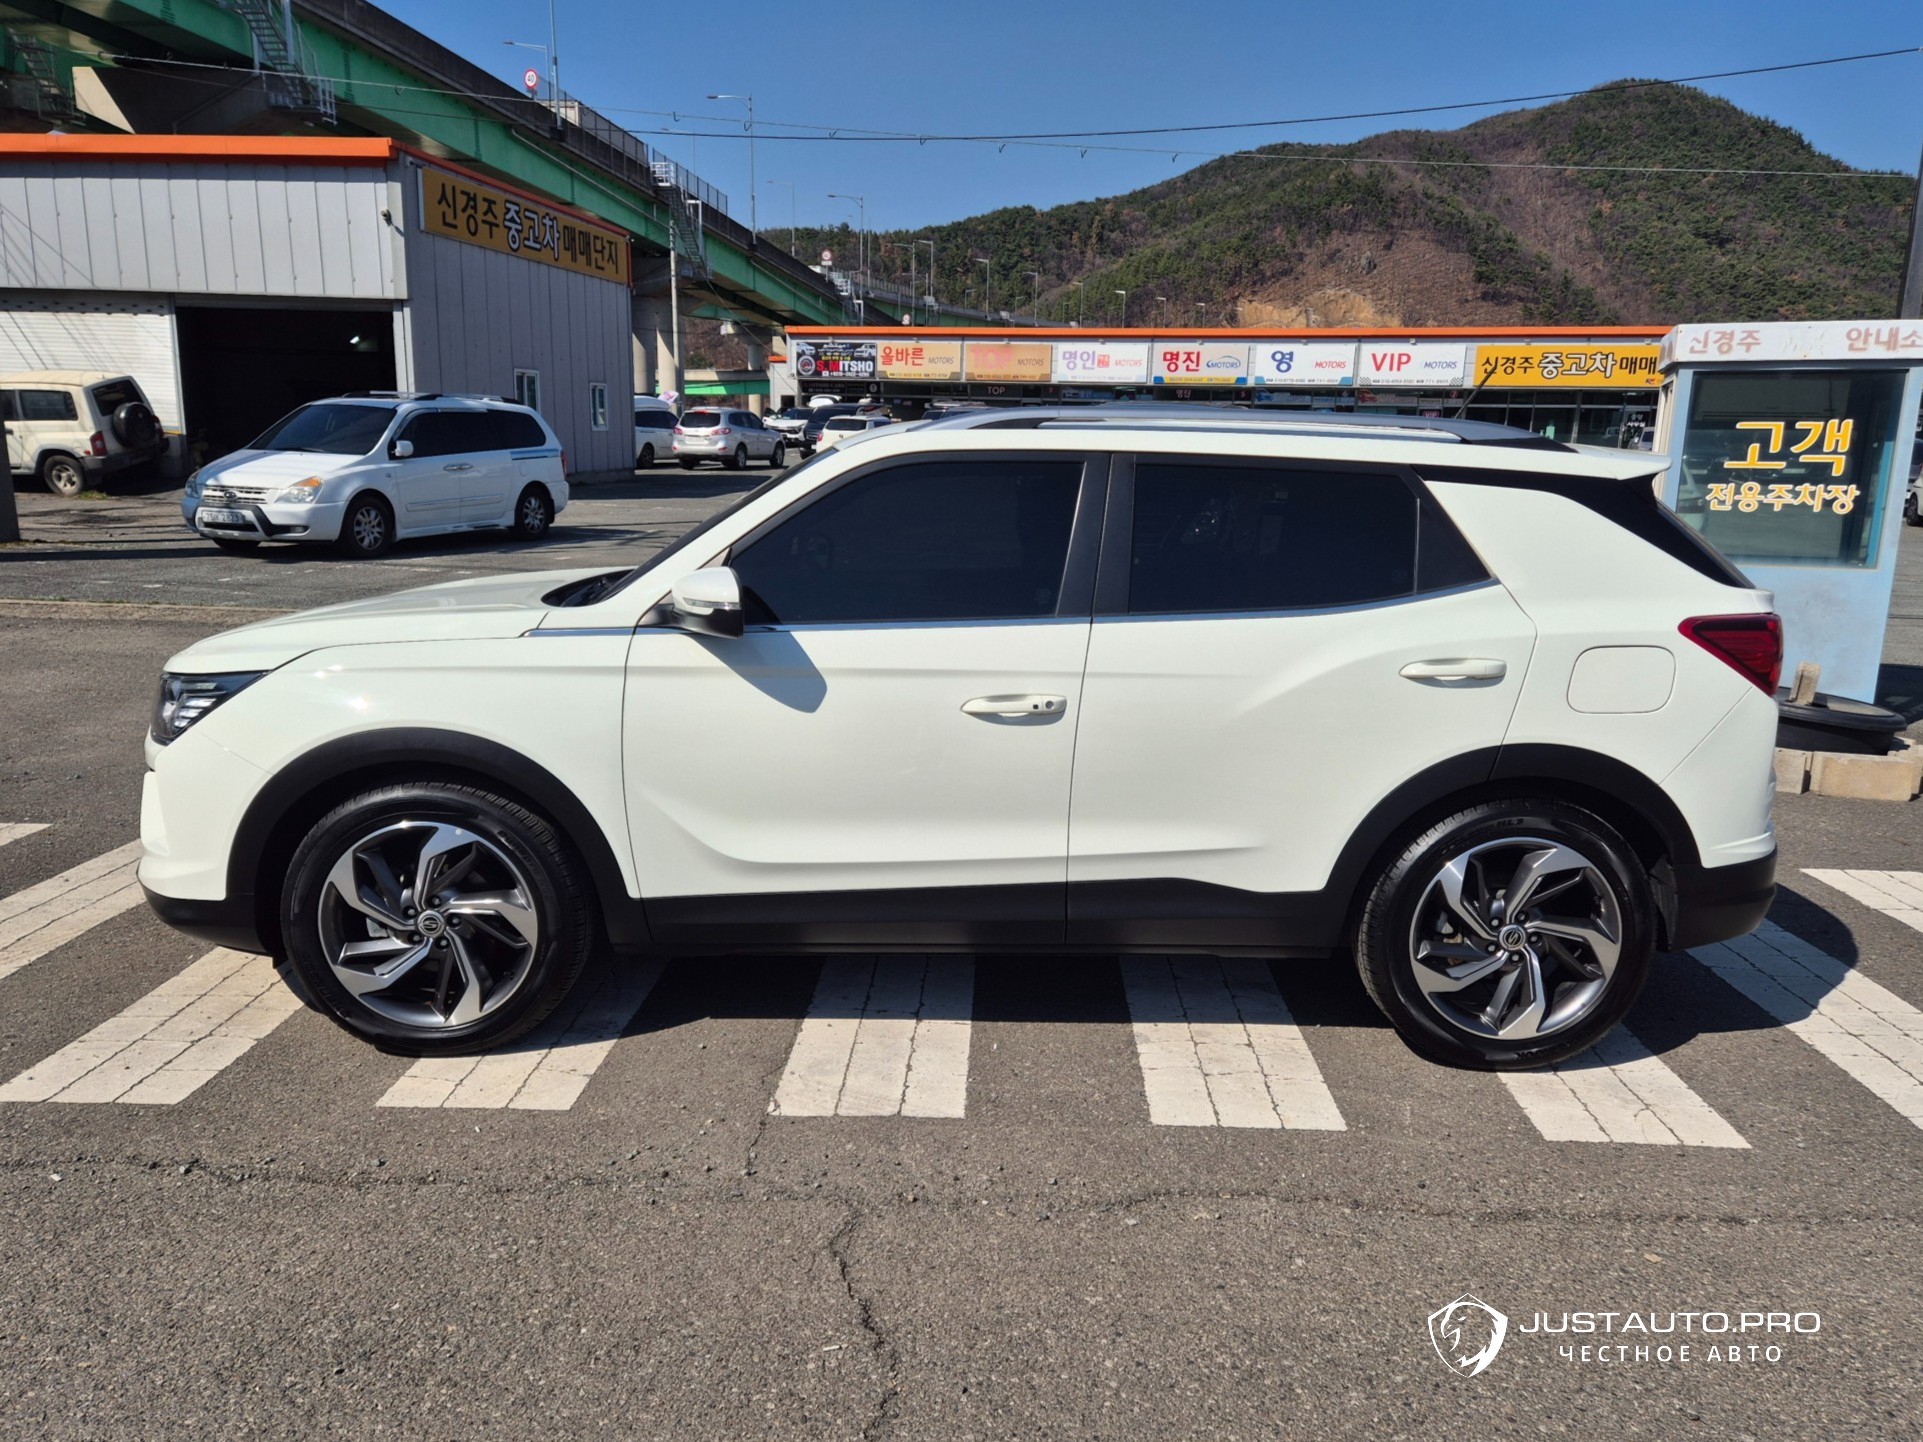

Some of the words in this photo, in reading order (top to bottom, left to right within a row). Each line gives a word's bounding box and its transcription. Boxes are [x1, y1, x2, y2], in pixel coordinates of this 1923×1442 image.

[437, 182, 499, 240] 신경주
[503, 200, 560, 262] 중고차
[563, 225, 619, 275] 매매단지
[1689, 329, 1762, 354] 신경주
[1846, 326, 1923, 351] 안내소
[881, 346, 925, 366] 올바른
[970, 346, 1014, 369] TOP
[1062, 350, 1096, 371] 명인
[1115, 359, 1142, 367] MOTORS
[1163, 351, 1201, 373] 명진
[1271, 350, 1294, 373] 영
[1314, 361, 1346, 369] MOTORS
[1371, 353, 1412, 372] VIP
[1424, 361, 1457, 369] MOTORS
[1482, 355, 1535, 376] 신경주
[1538, 351, 1618, 379] 중고차
[987, 386, 1006, 395] TOP
[1723, 419, 1854, 477] 고객
[1705, 481, 1861, 515] 전용주차장
